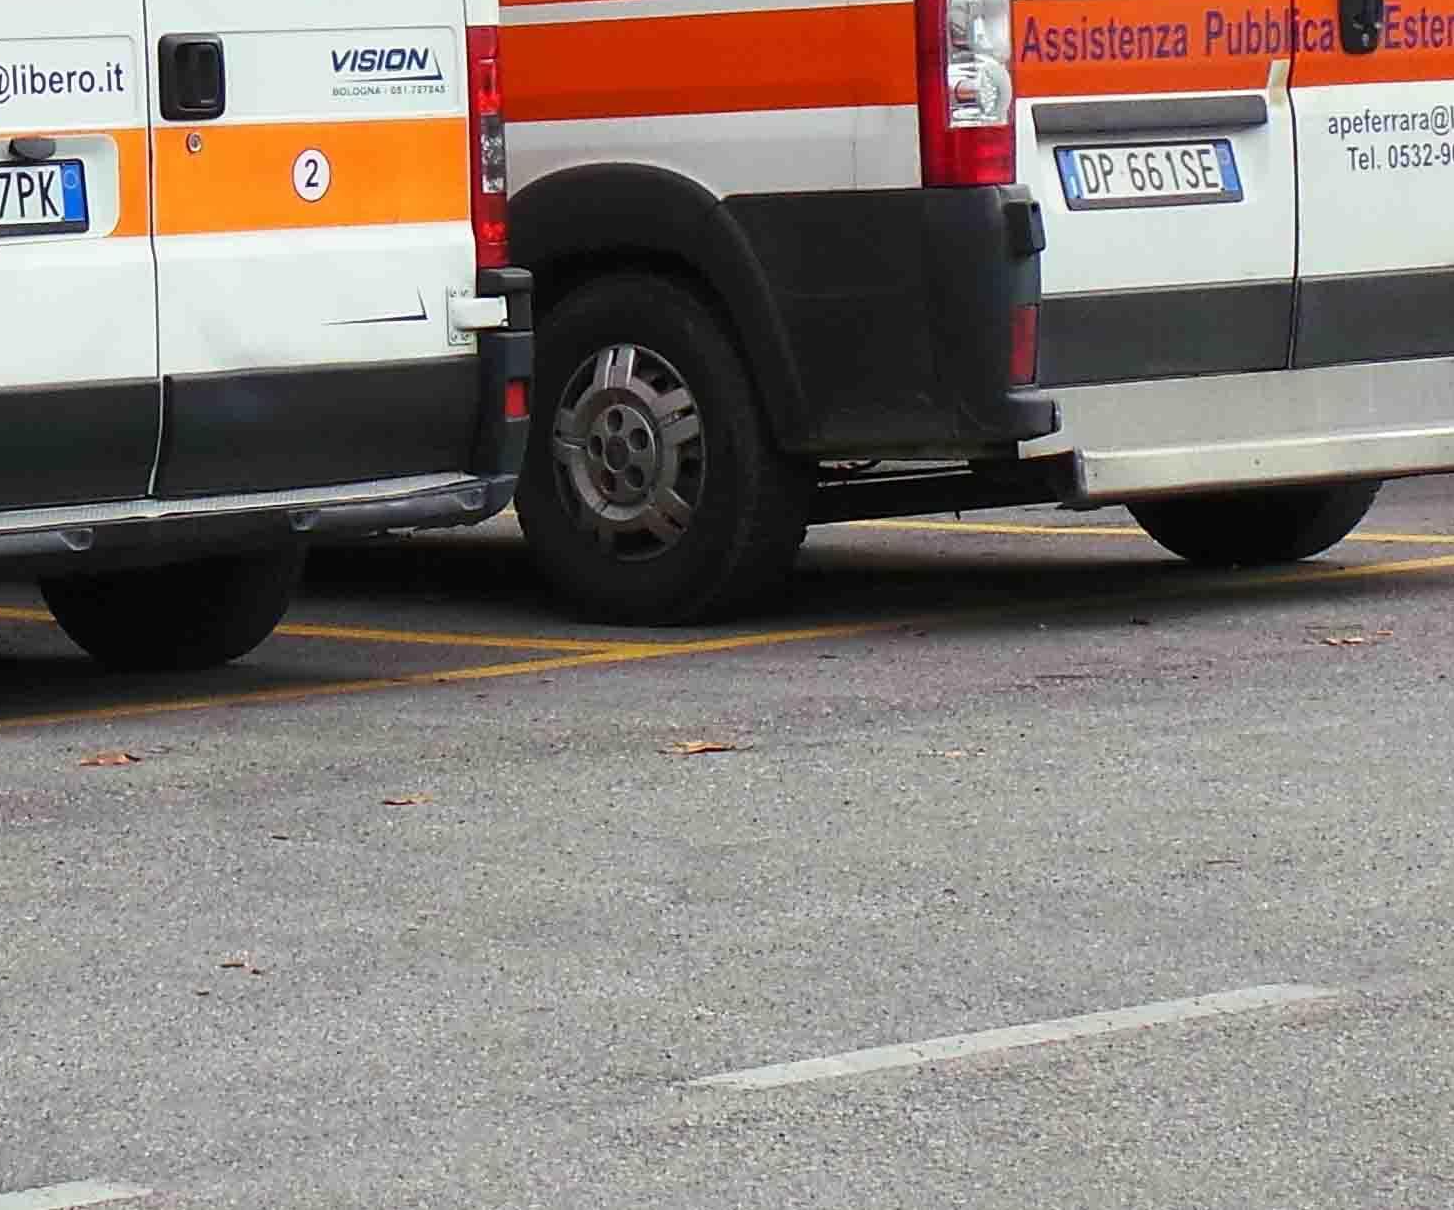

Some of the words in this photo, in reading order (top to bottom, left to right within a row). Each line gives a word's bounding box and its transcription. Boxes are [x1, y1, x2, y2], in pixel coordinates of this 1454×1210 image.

[1021, 15, 1188, 63] Assistenza
[1204, 9, 1334, 57] Pubblica
[330, 47, 429, 73] VISION
[331, 86, 381, 97] BOLOGNA
[304, 158, 319, 188] 2
[1079, 152, 1114, 195] DP
[1126, 148, 1220, 191] 661SE
[1346, 146, 1382, 172] Tel.
